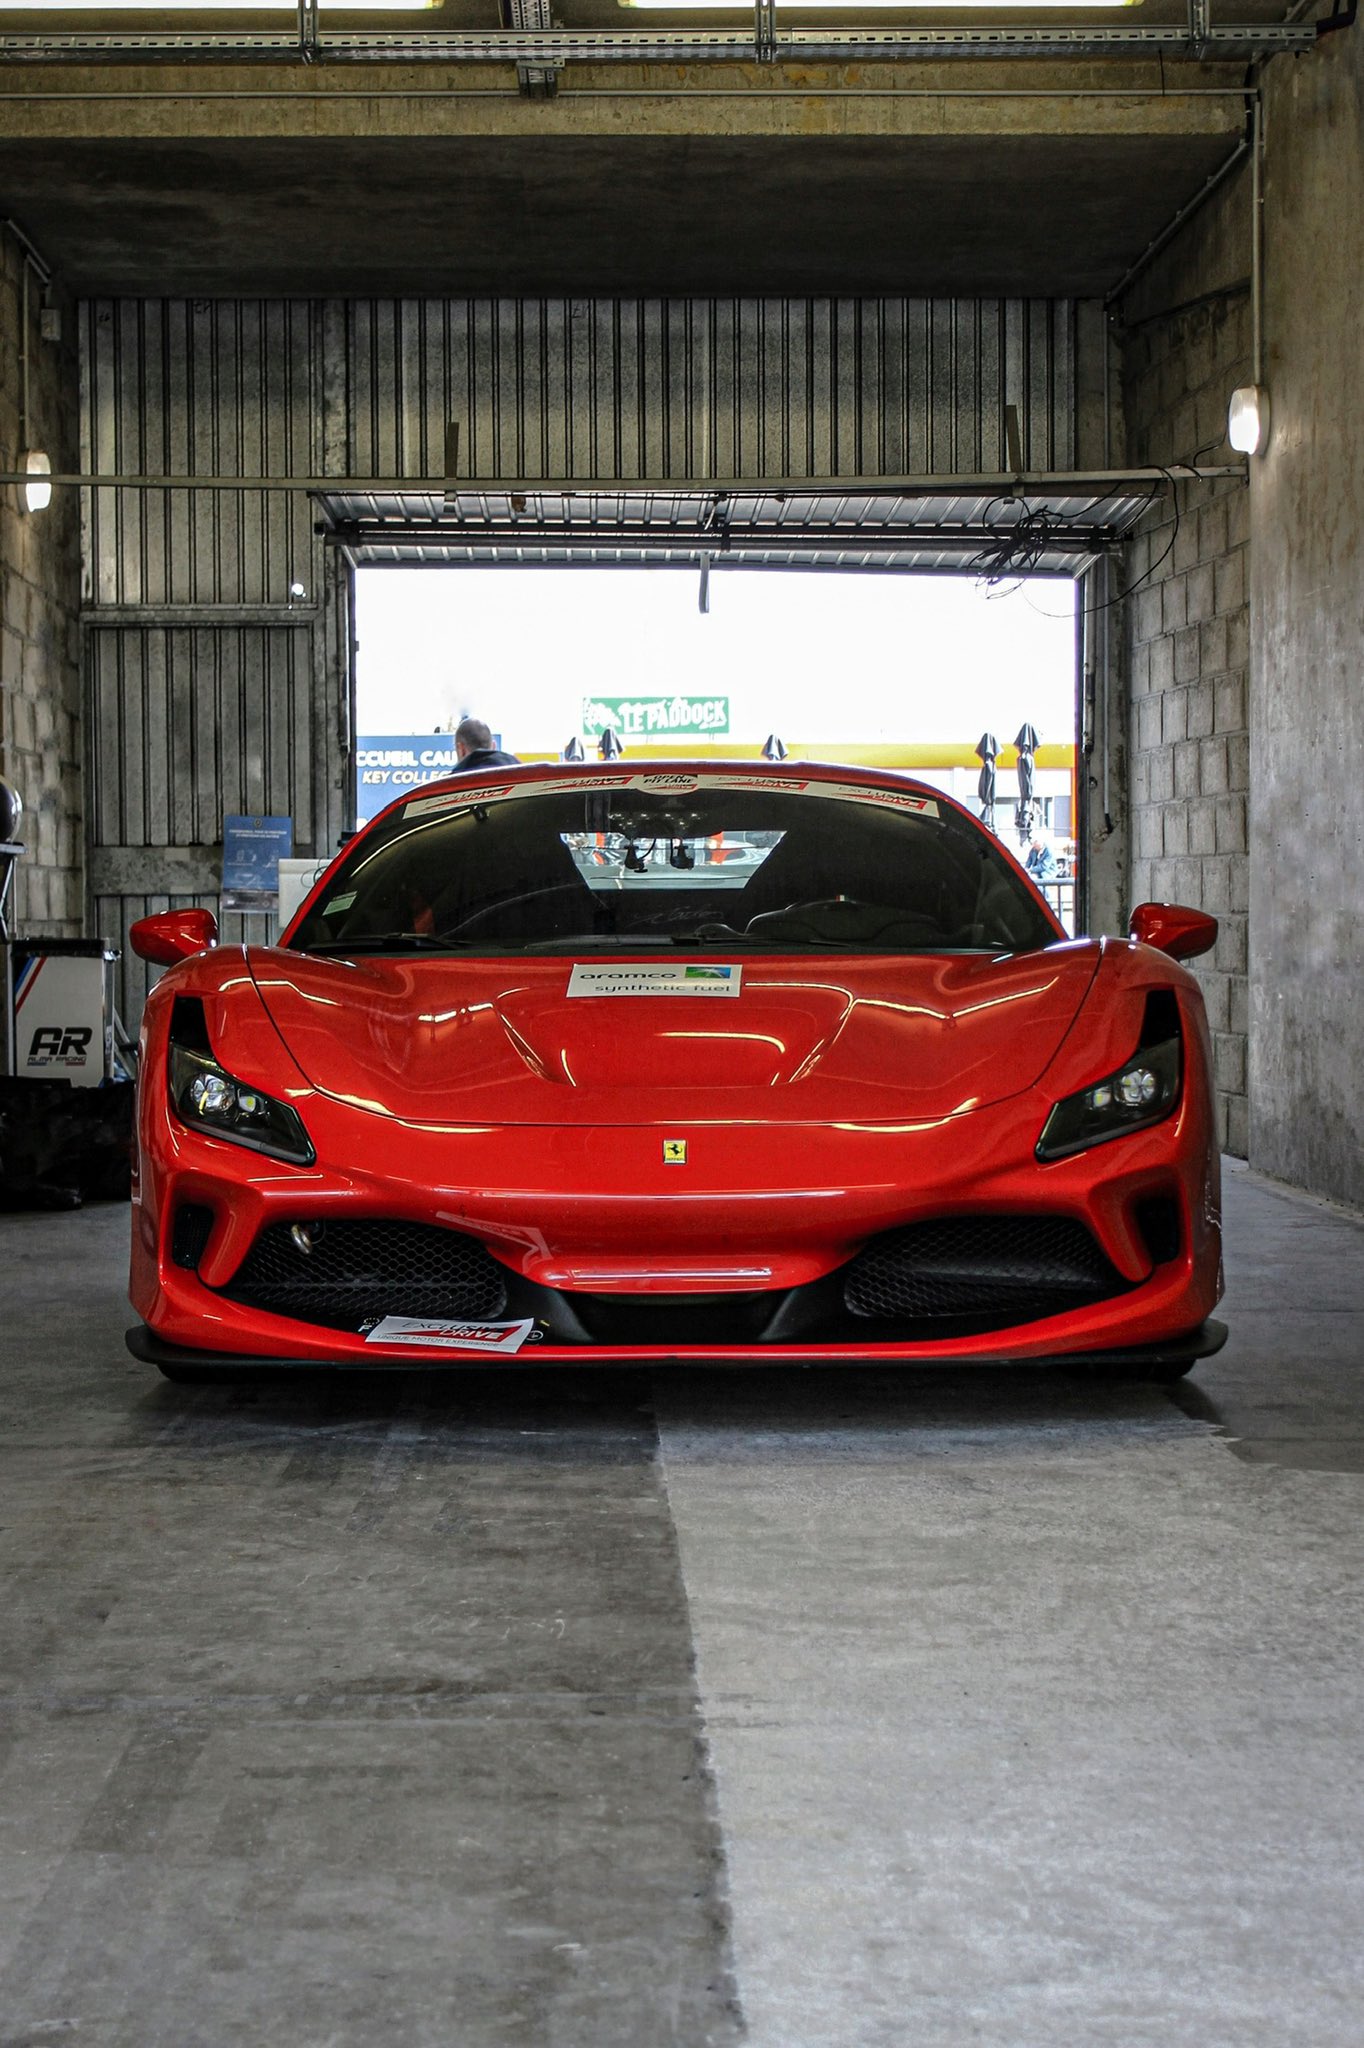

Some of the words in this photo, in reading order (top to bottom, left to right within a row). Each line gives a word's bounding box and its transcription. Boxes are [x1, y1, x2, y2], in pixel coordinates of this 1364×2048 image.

[644, 696, 727, 730] PADDOCK
[362, 770, 391, 784] KEY
[580, 972, 676, 980] aramco
[595, 984, 686, 993] synthetic
[29, 1027, 92, 1055] AR
[401, 1322, 506, 1334] EXCLUSIVE
[440, 1329, 504, 1340] DRIVE
[444, 1338, 499, 1348] EXPERIENCE
